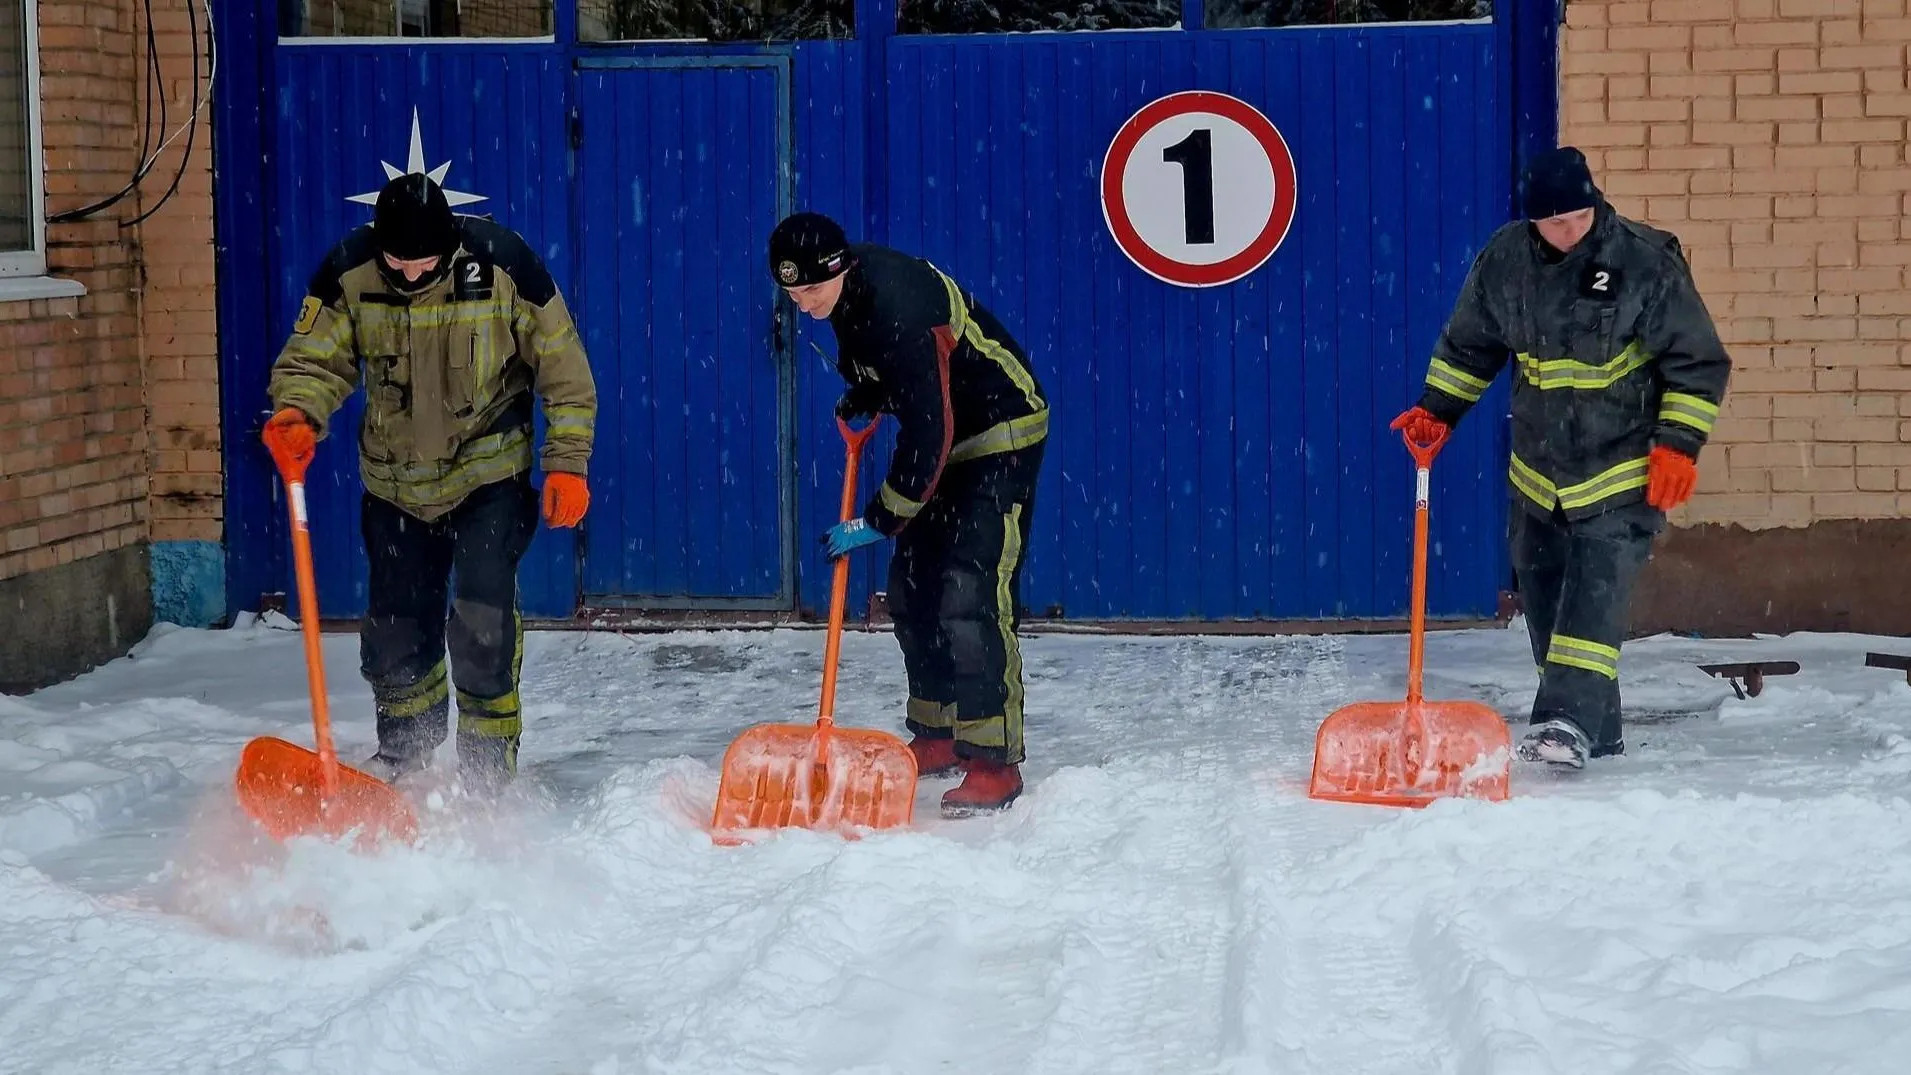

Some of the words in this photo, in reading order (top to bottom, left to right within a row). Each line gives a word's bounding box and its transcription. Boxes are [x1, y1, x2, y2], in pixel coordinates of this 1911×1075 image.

[1163, 129, 1215, 244] 1
[467, 262, 481, 283] 2
[1592, 271, 1610, 291] 2
